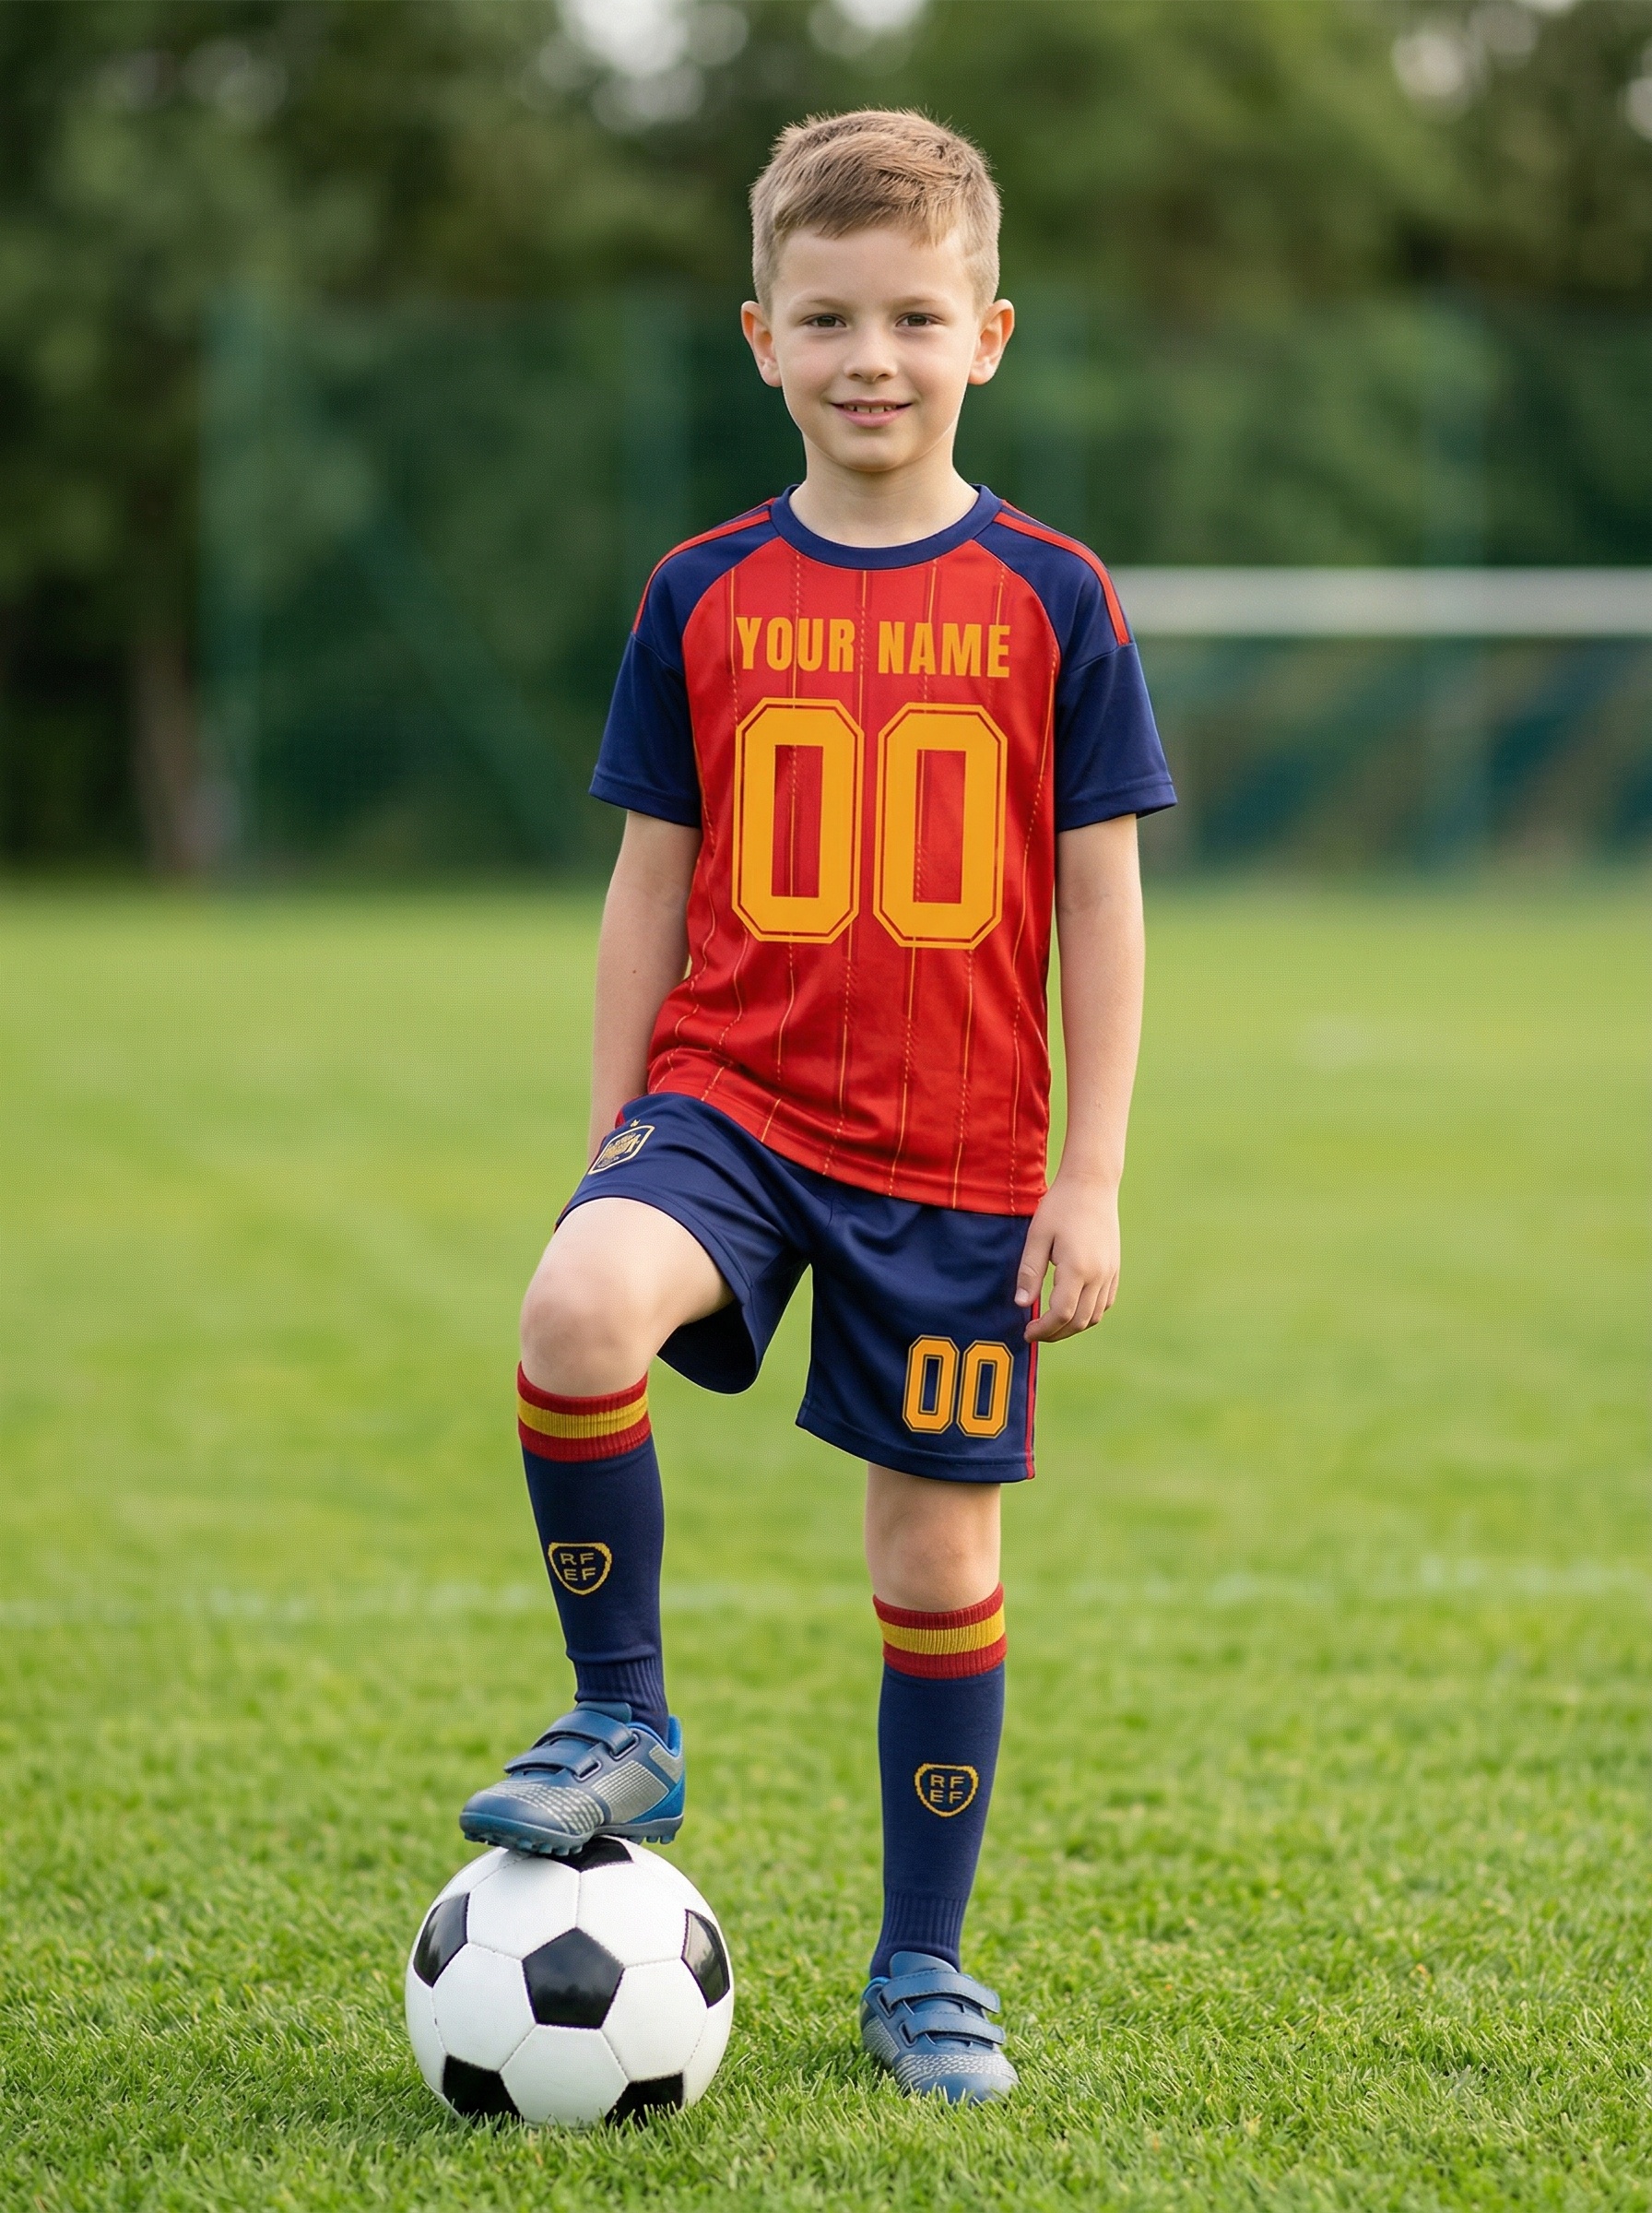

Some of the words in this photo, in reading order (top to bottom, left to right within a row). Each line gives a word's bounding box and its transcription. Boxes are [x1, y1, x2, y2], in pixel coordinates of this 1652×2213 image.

[736, 617, 855, 672] YOUR
[879, 621, 1010, 678] NAME
[731, 697, 1008, 950] 00
[903, 1334, 1014, 1438] 00
[560, 1553, 594, 1565] RF
[563, 1568, 596, 1580] EF
[930, 1774, 964, 1789] RF
[930, 1790, 963, 1804] EF
